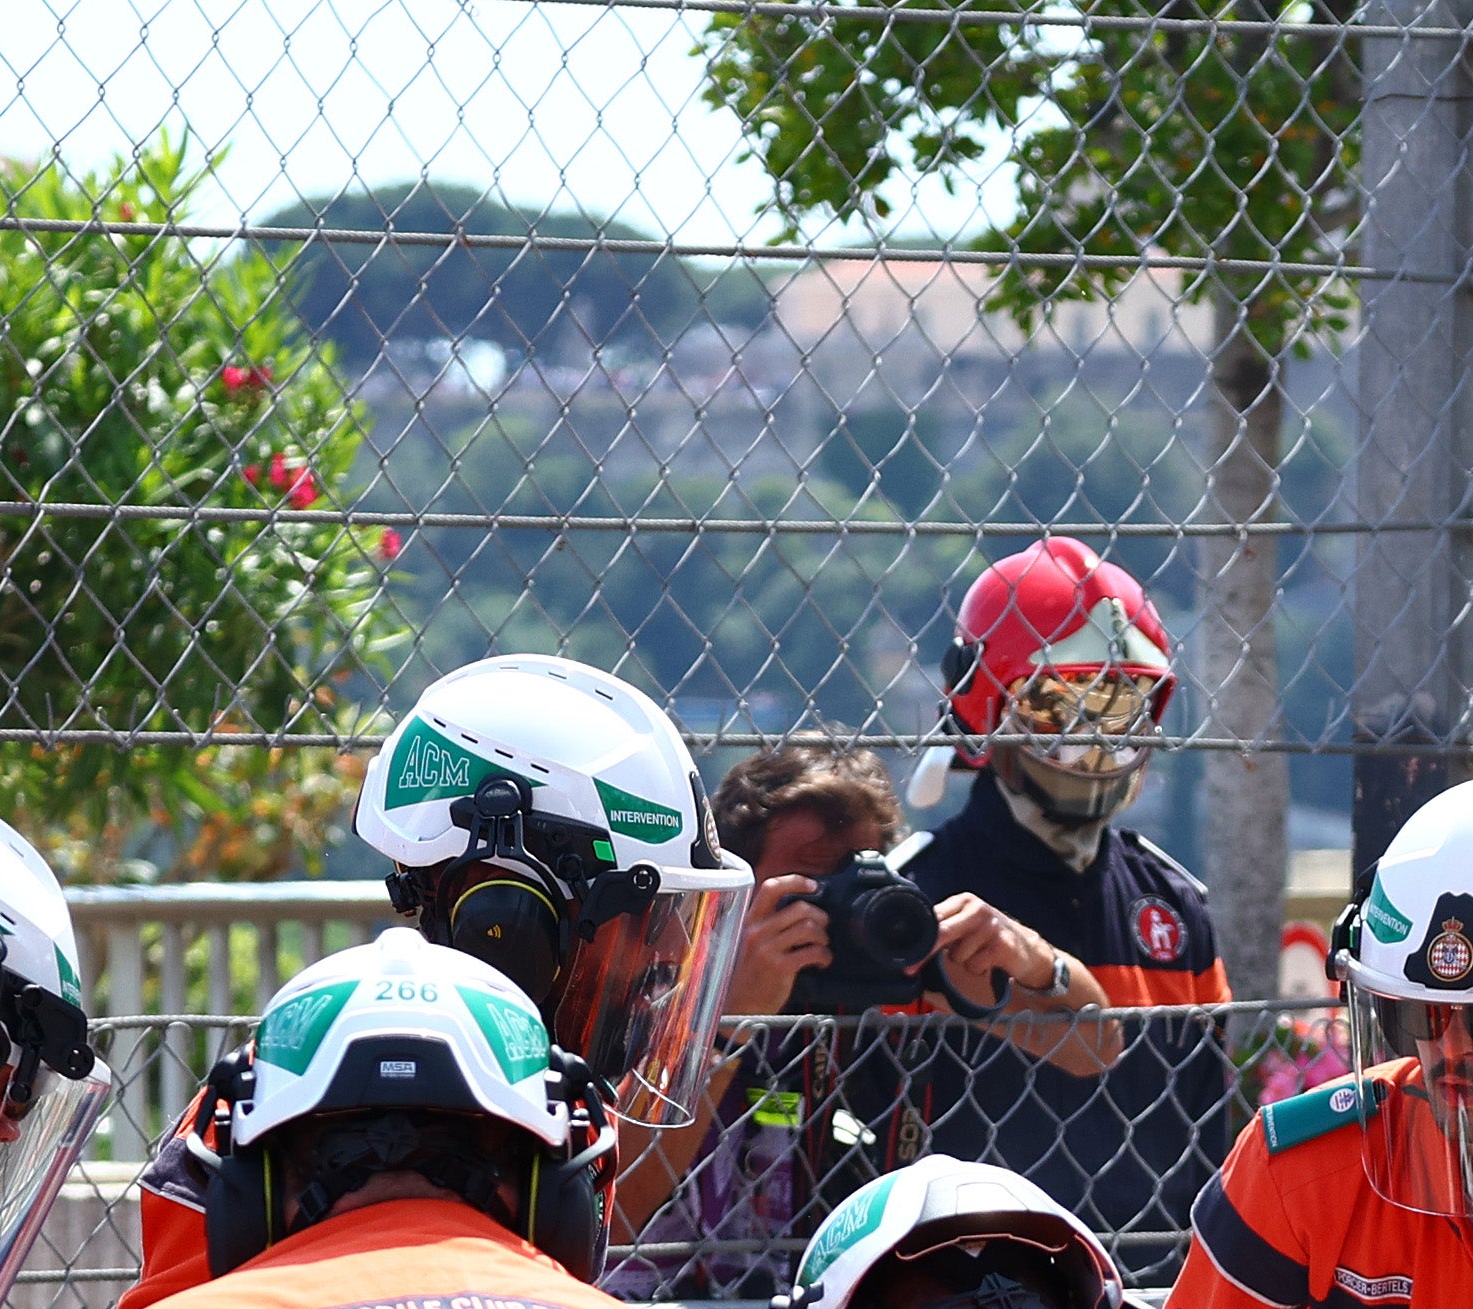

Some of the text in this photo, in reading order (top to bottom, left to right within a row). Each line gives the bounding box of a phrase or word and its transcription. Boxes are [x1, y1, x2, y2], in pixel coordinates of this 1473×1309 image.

[398, 735, 469, 789] ACM
[610, 809, 679, 828] INTERVENTION
[376, 980, 438, 1003] 266
[382, 1062, 415, 1073] MSA
[1265, 1105, 1278, 1149] TERVENTION
